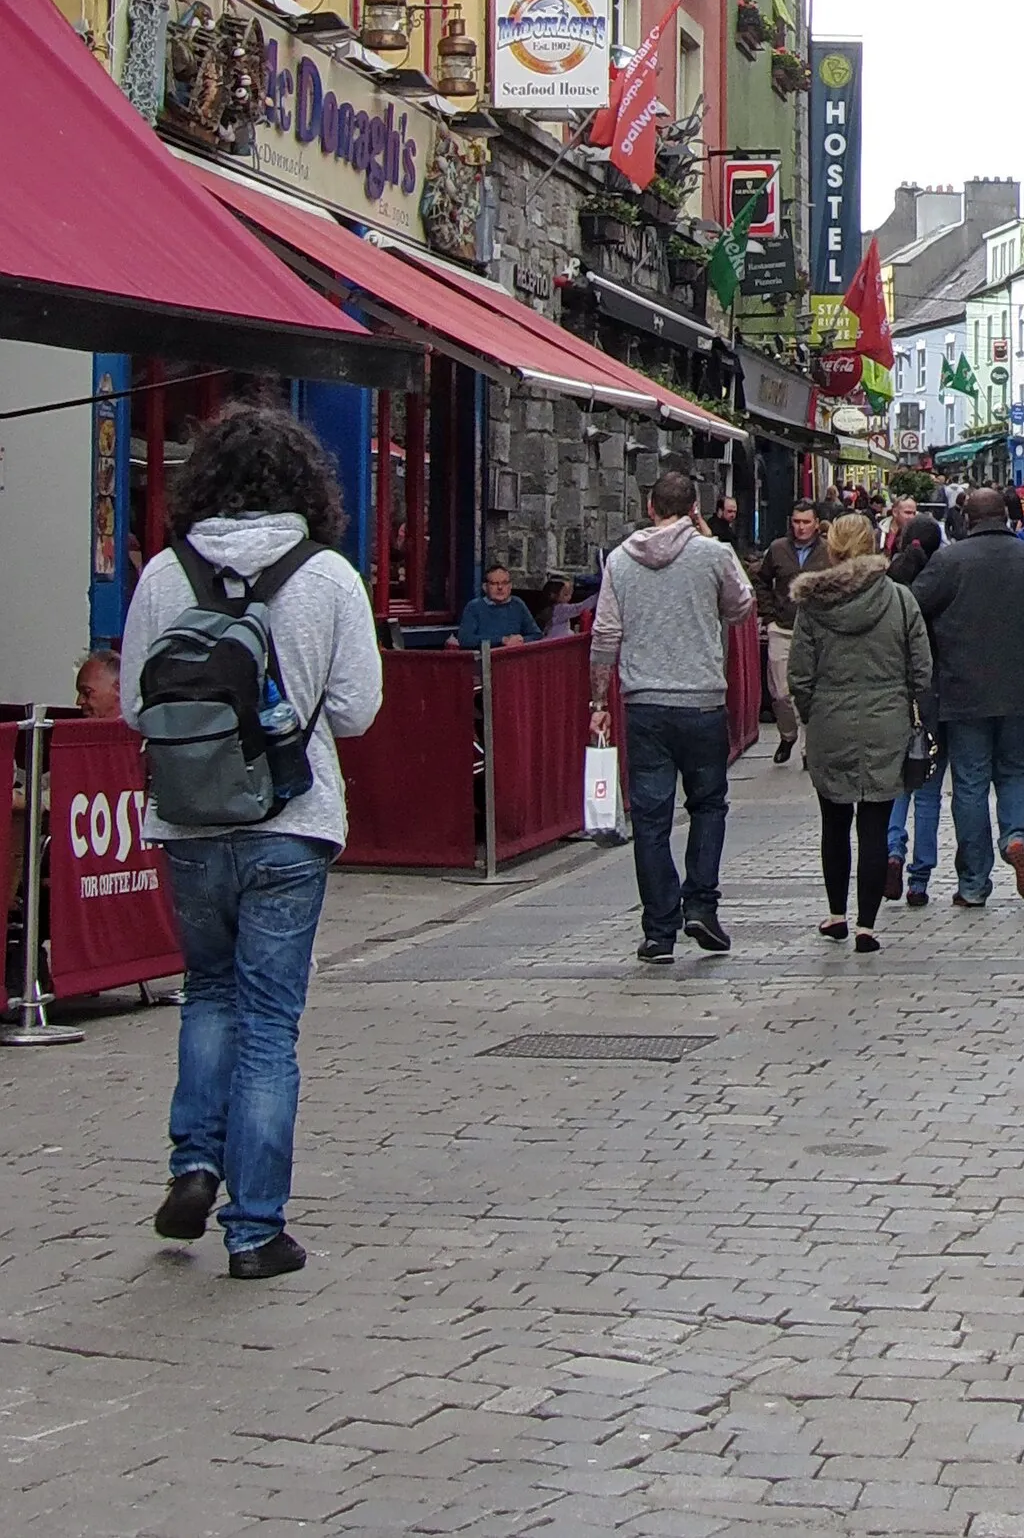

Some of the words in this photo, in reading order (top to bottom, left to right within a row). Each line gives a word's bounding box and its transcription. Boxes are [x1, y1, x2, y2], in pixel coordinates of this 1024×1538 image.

[552, 42, 570, 50] 1902
[502, 82, 555, 95] Seafood
[560, 82, 600, 95] House
[296, 56, 417, 200] Donagh's
[621, 96, 657, 156] galwa
[824, 100, 847, 283] HOSTEL
[81, 875, 99, 899] FOR
[100, 871, 131, 896] COFFEE
